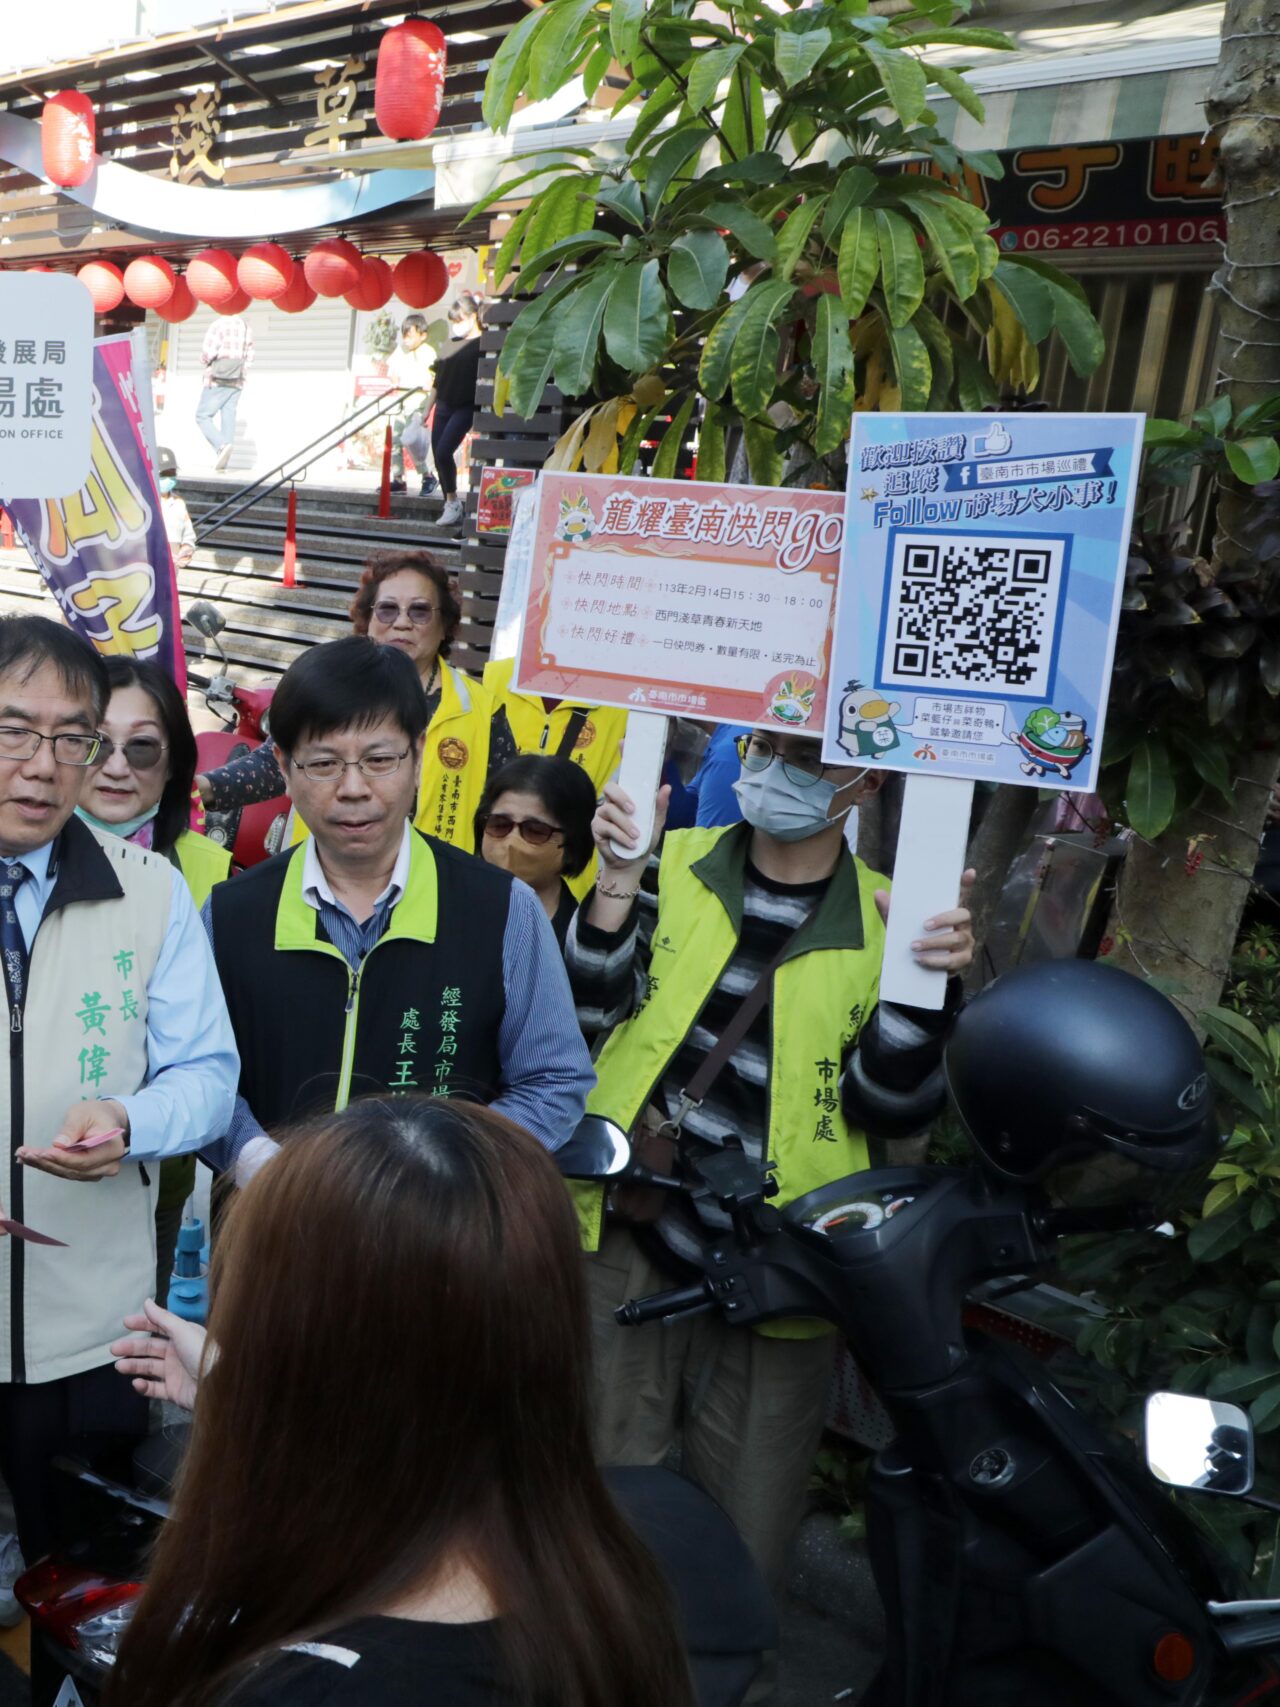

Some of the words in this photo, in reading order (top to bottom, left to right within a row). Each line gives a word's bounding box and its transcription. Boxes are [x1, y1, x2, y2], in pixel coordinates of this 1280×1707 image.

[1023, 220, 1219, 250] 06-2210106
[20, 429, 64, 440] OFFICE
[860, 433, 966, 471] 歡迎按讚
[884, 465, 940, 497] 追蹤
[979, 457, 1089, 483] 臺南市市場巡禮
[873, 496, 962, 528] Follow
[577, 569, 642, 591] 快閃時間
[573, 597, 638, 617] 快閃地點
[655, 608, 763, 632] 西門淺草青春新天地
[570, 624, 635, 646] 快閃好禮
[113, 949, 139, 1022] 市長
[74, 991, 112, 1101] 黃偉
[388, 1007, 422, 1096] 處長王
[812, 1057, 838, 1143] 市場處
